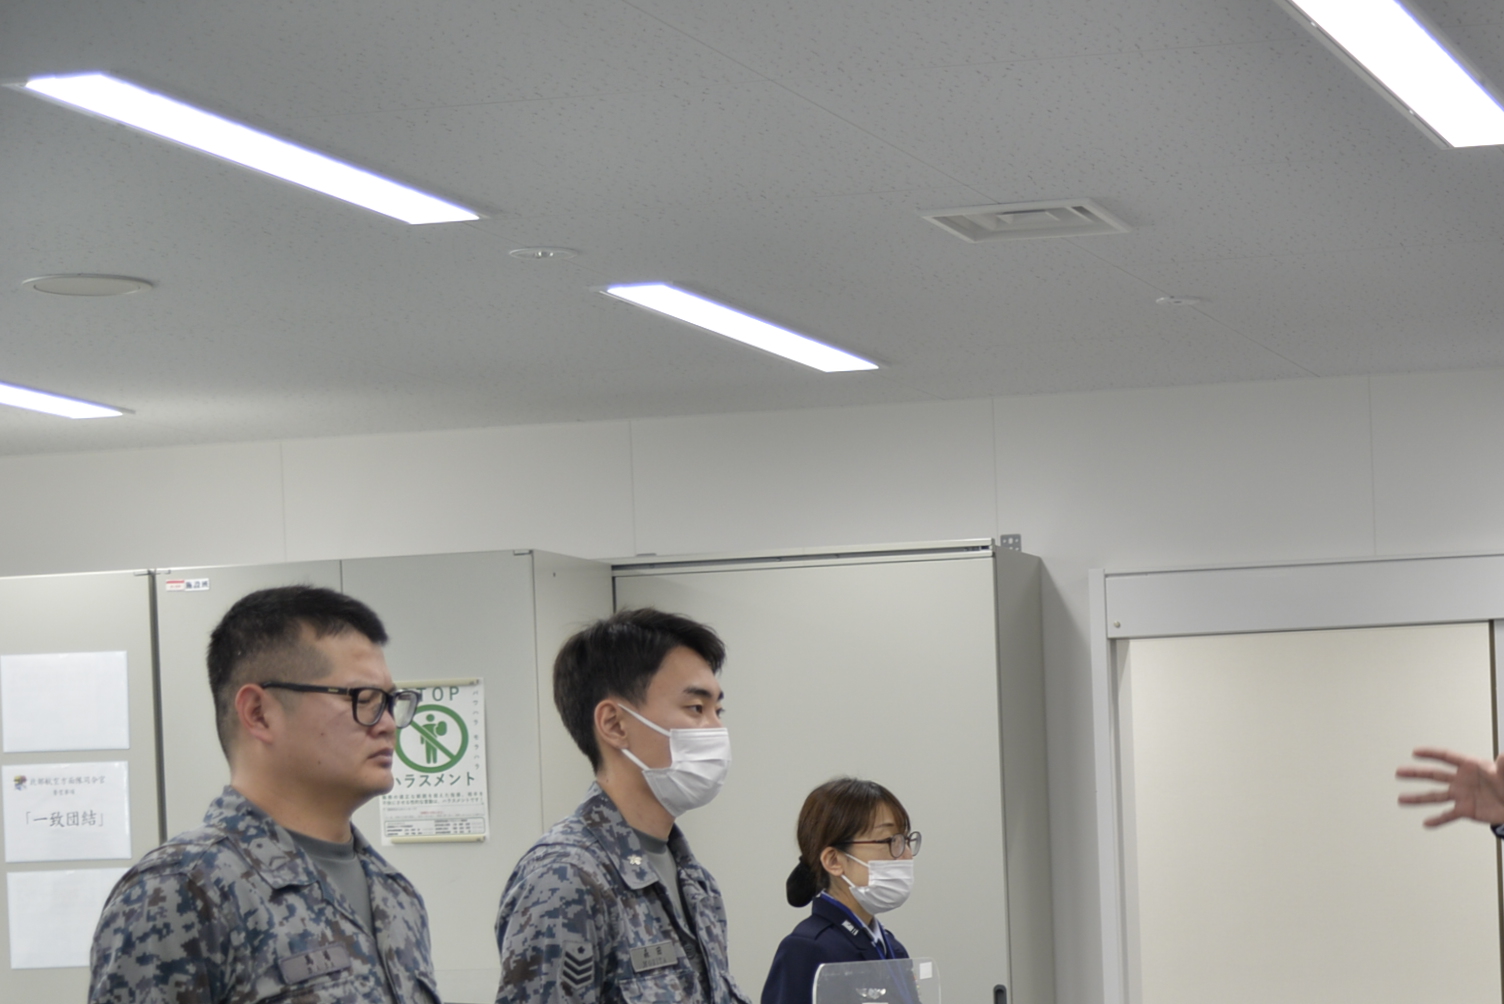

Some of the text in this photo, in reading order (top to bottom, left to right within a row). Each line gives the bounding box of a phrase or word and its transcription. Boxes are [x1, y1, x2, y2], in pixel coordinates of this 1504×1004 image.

[402, 686, 460, 702] TOP
[25, 809, 104, 828] 「一致団結」
